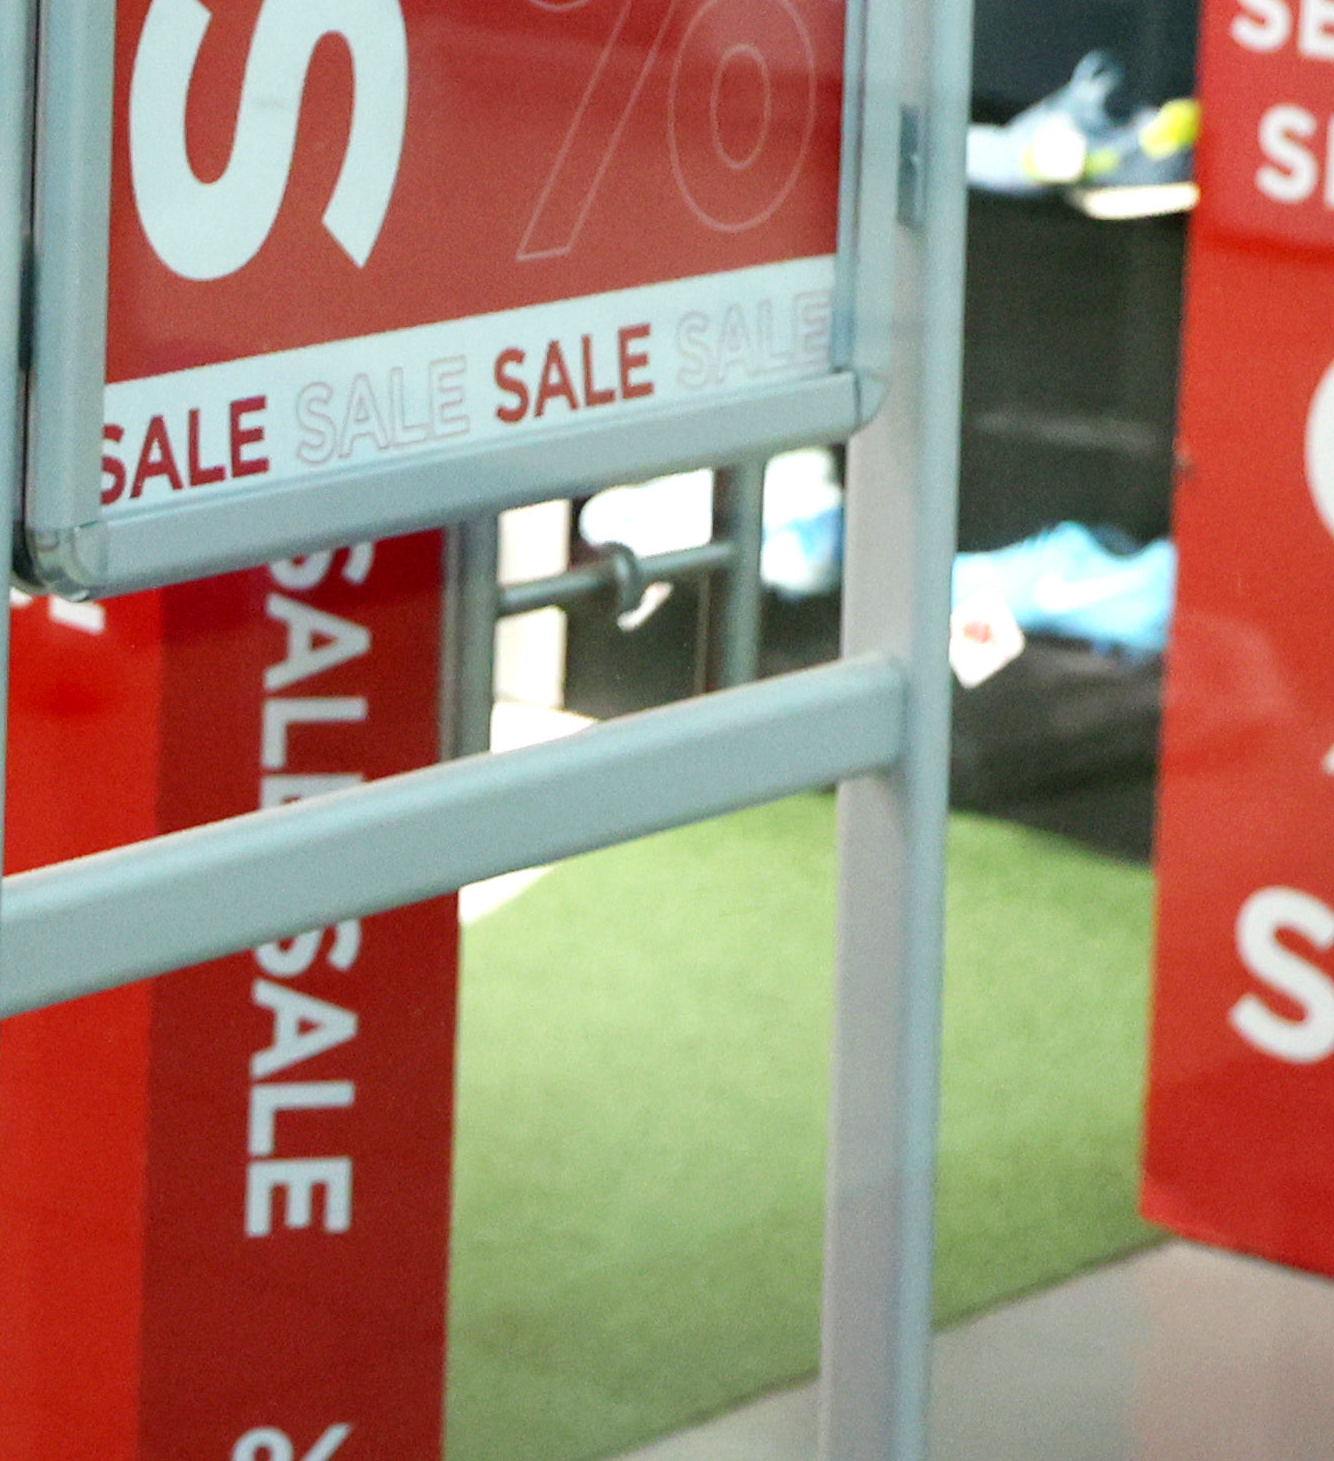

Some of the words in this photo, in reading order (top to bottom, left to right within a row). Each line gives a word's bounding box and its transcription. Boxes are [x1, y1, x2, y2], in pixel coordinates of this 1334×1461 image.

[100, 396, 269, 505] SALE
[297, 355, 468, 464] SALE
[495, 324, 653, 421] SALE
[675, 290, 830, 388] SALE
[245, 920, 361, 1237] SALE
